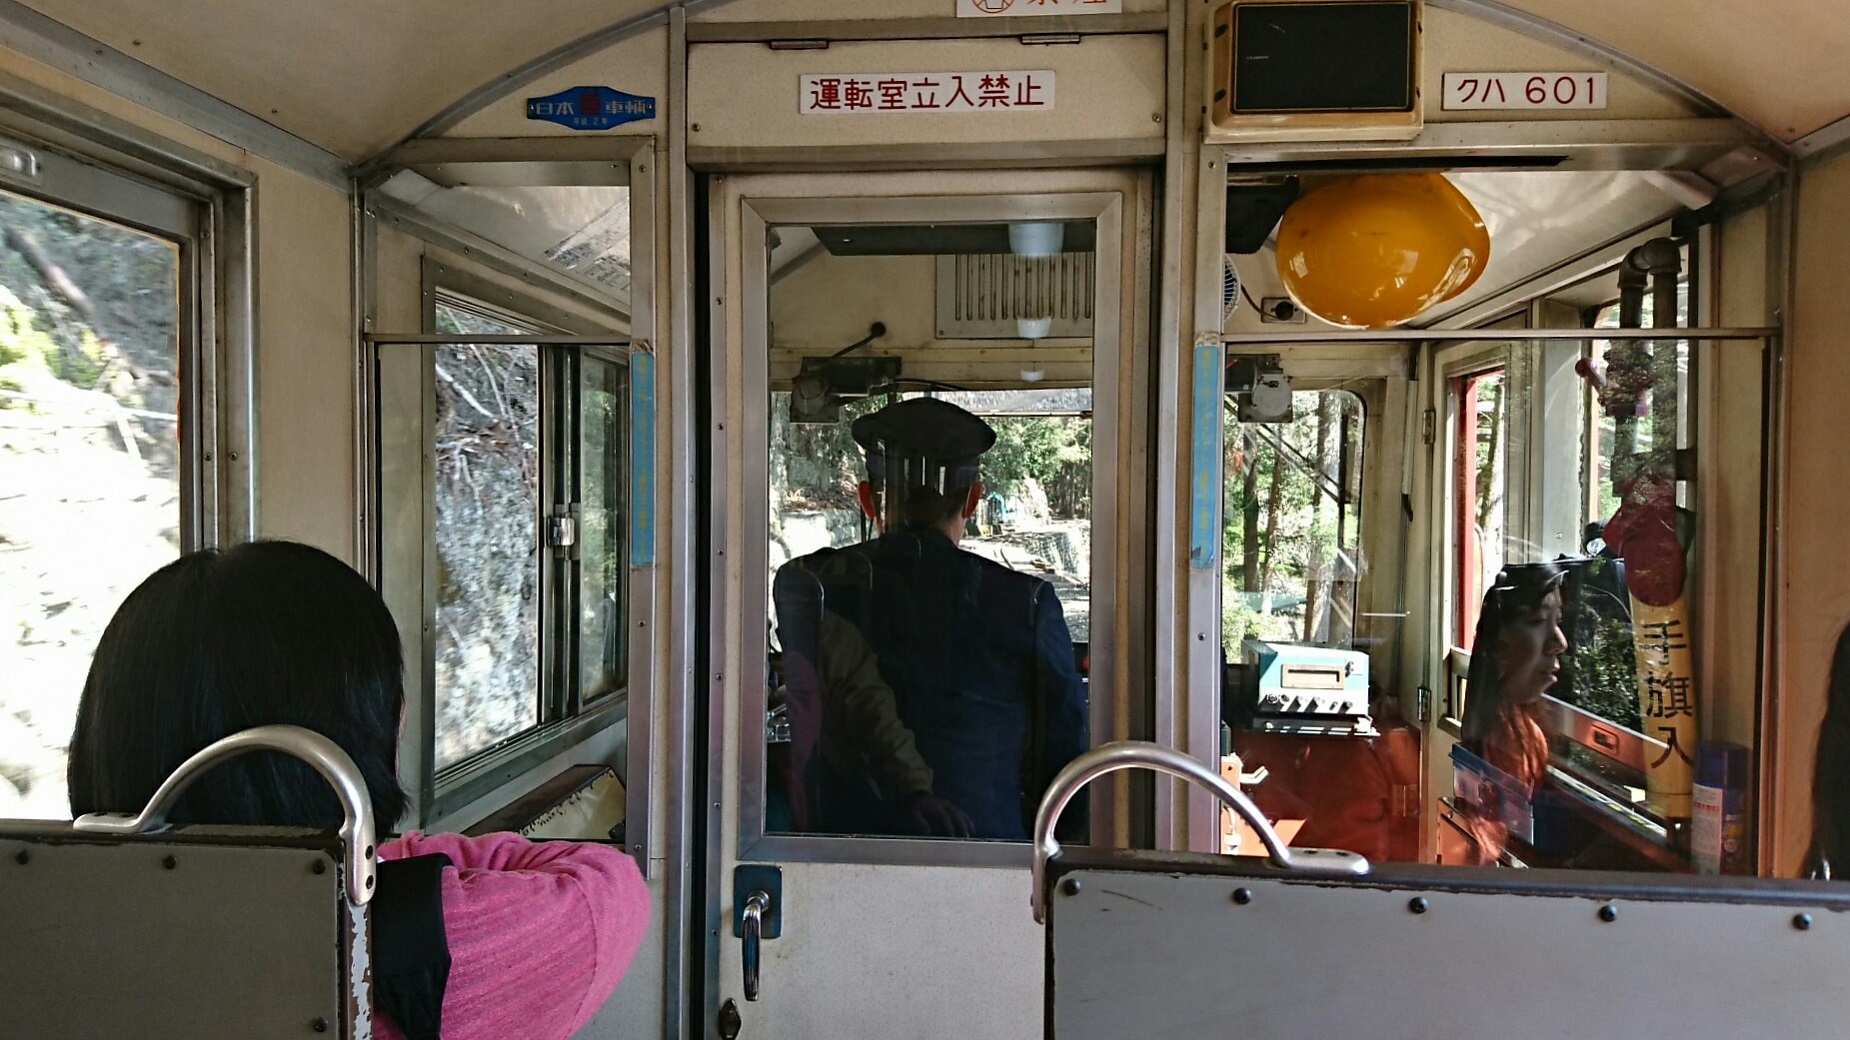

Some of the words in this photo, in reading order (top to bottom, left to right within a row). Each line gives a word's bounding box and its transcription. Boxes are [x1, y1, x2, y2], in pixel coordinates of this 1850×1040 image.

[809, 74, 1045, 111] 運転室立入禁止
[1457, 79, 1506, 103] クハ
[1526, 77, 1594, 104] 601
[537, 102, 574, 115] 日本
[1642, 620, 1693, 769] 手旗入
